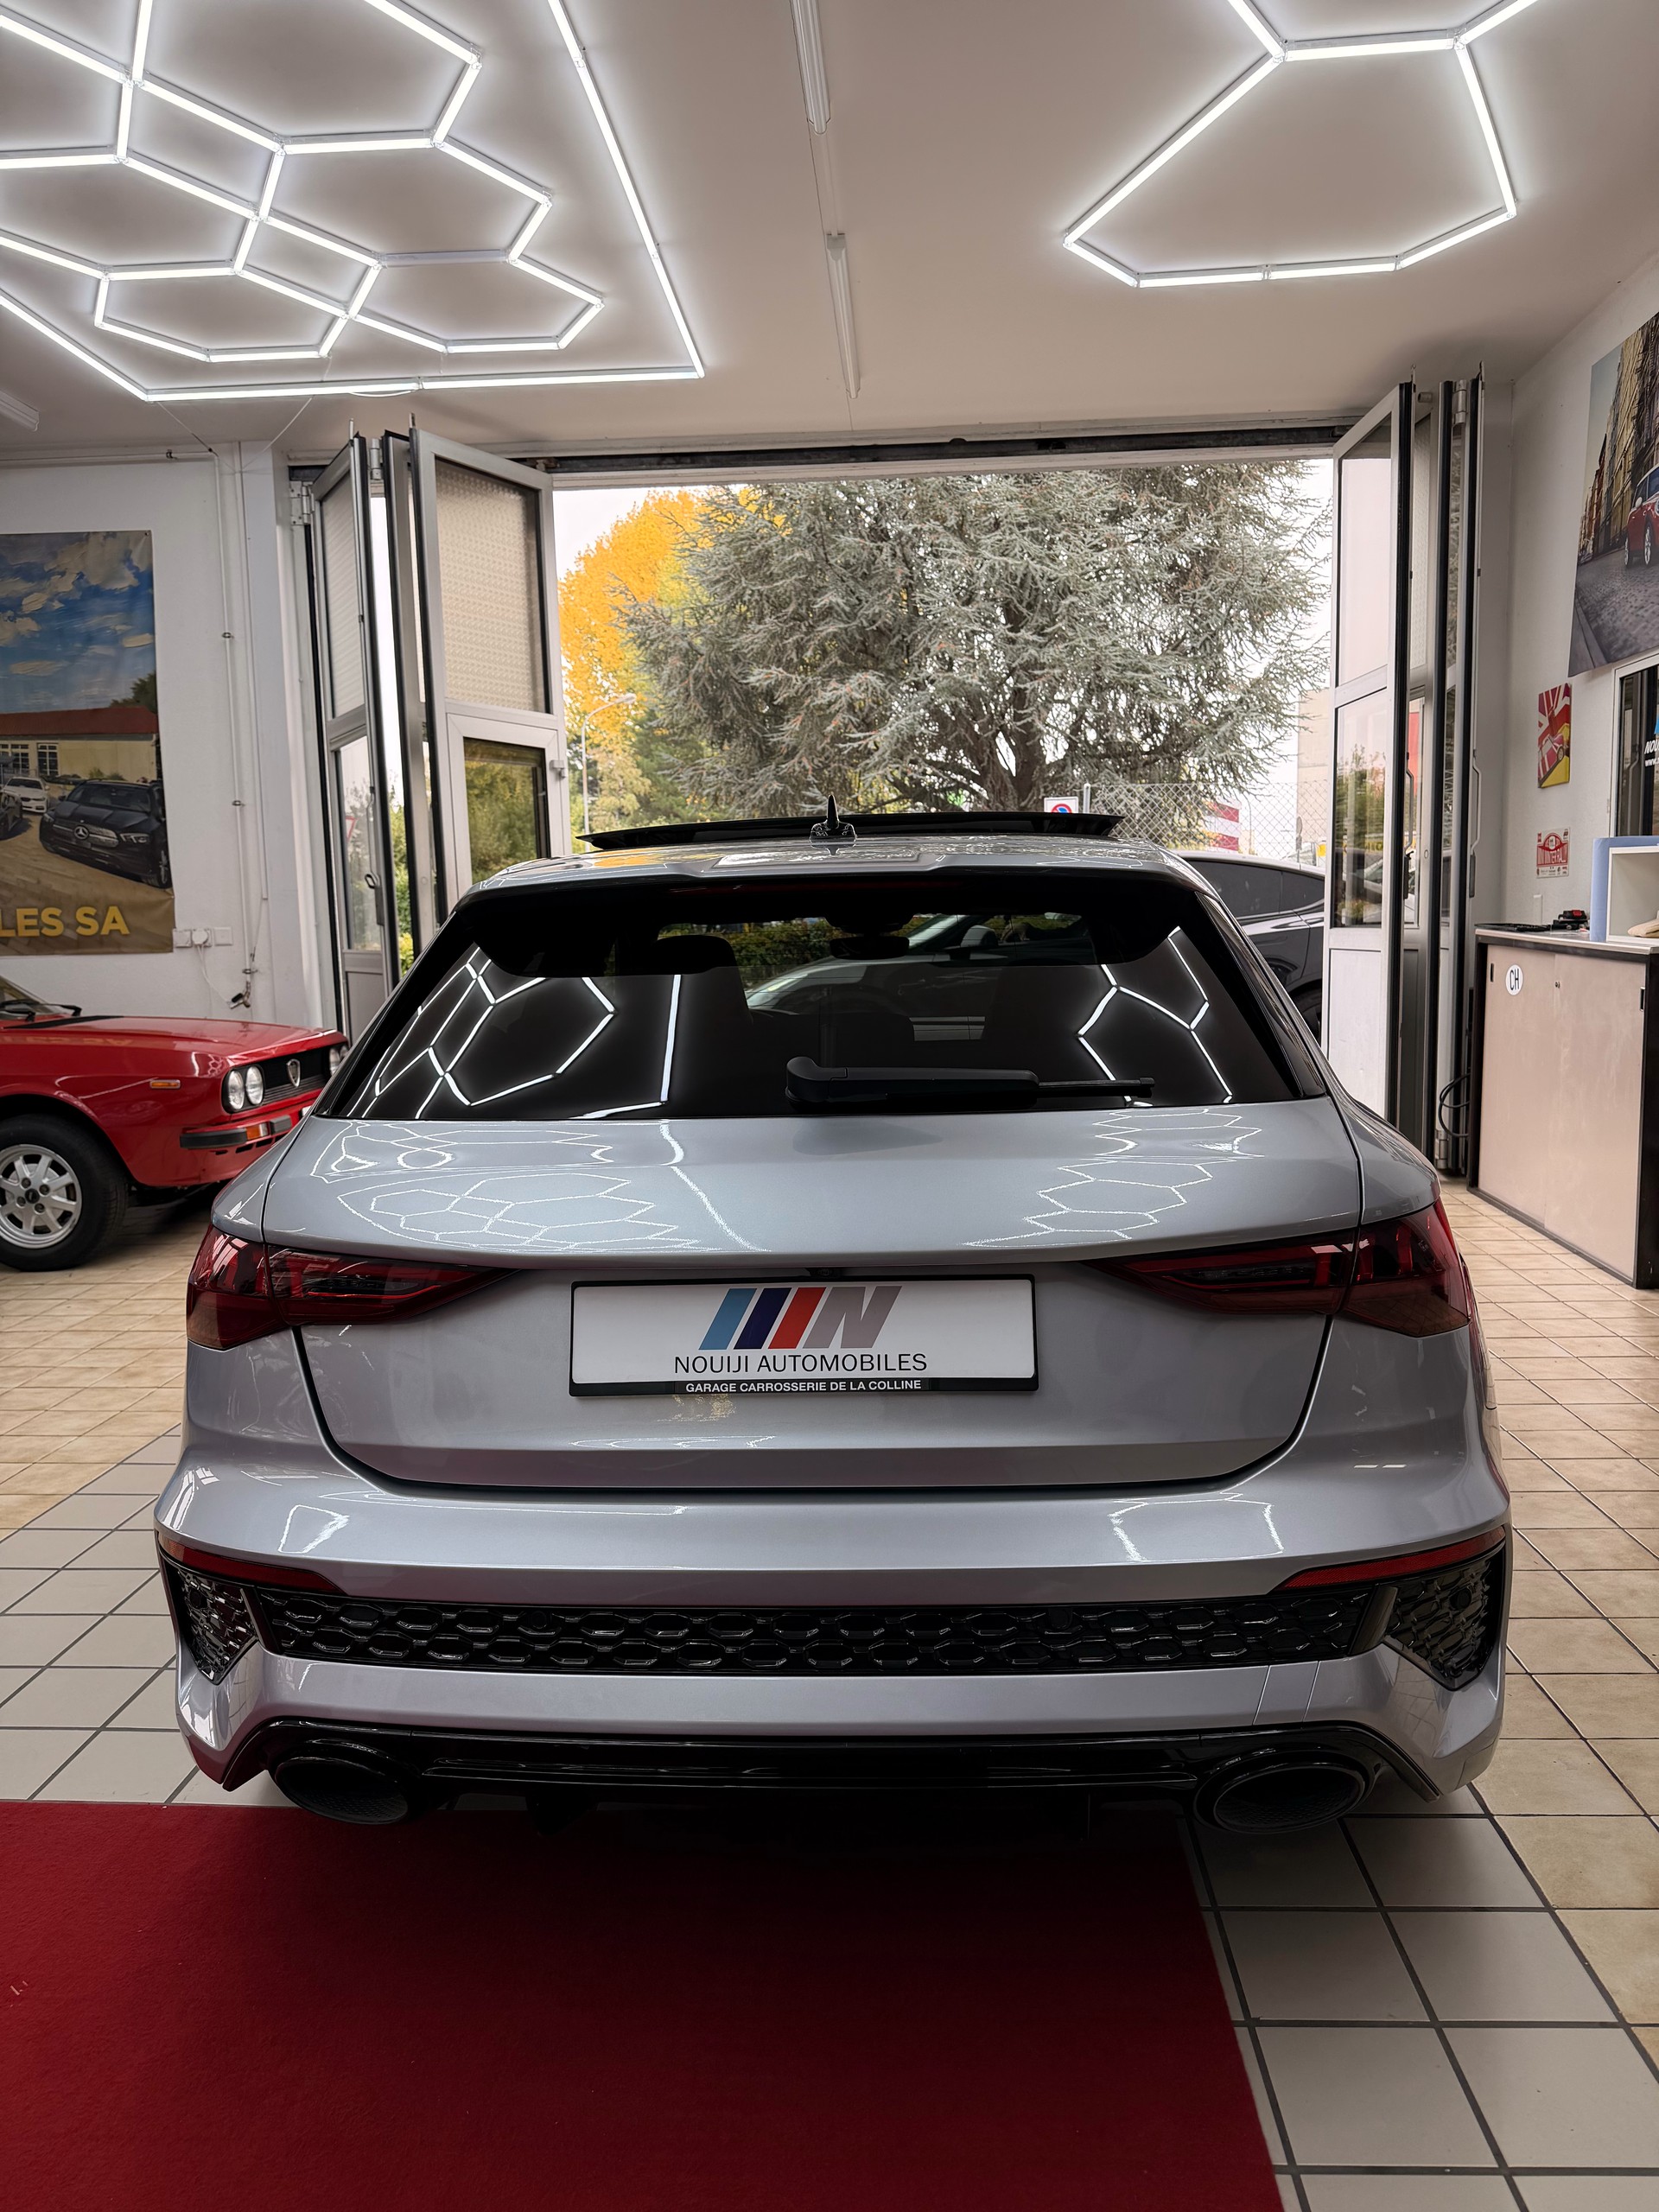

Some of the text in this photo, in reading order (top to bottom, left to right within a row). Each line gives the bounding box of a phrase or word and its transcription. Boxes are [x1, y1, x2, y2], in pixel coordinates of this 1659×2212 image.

[1644, 740, 1659, 754] NOU
[0, 906, 130, 937] LES SA
[1510, 969, 1519, 990] CH
[674, 1353, 927, 1374] NOUIJI AUTOMOBILES
[685, 1380, 922, 1393] GARAGE CARROSSERIE DE LA COLLINE
